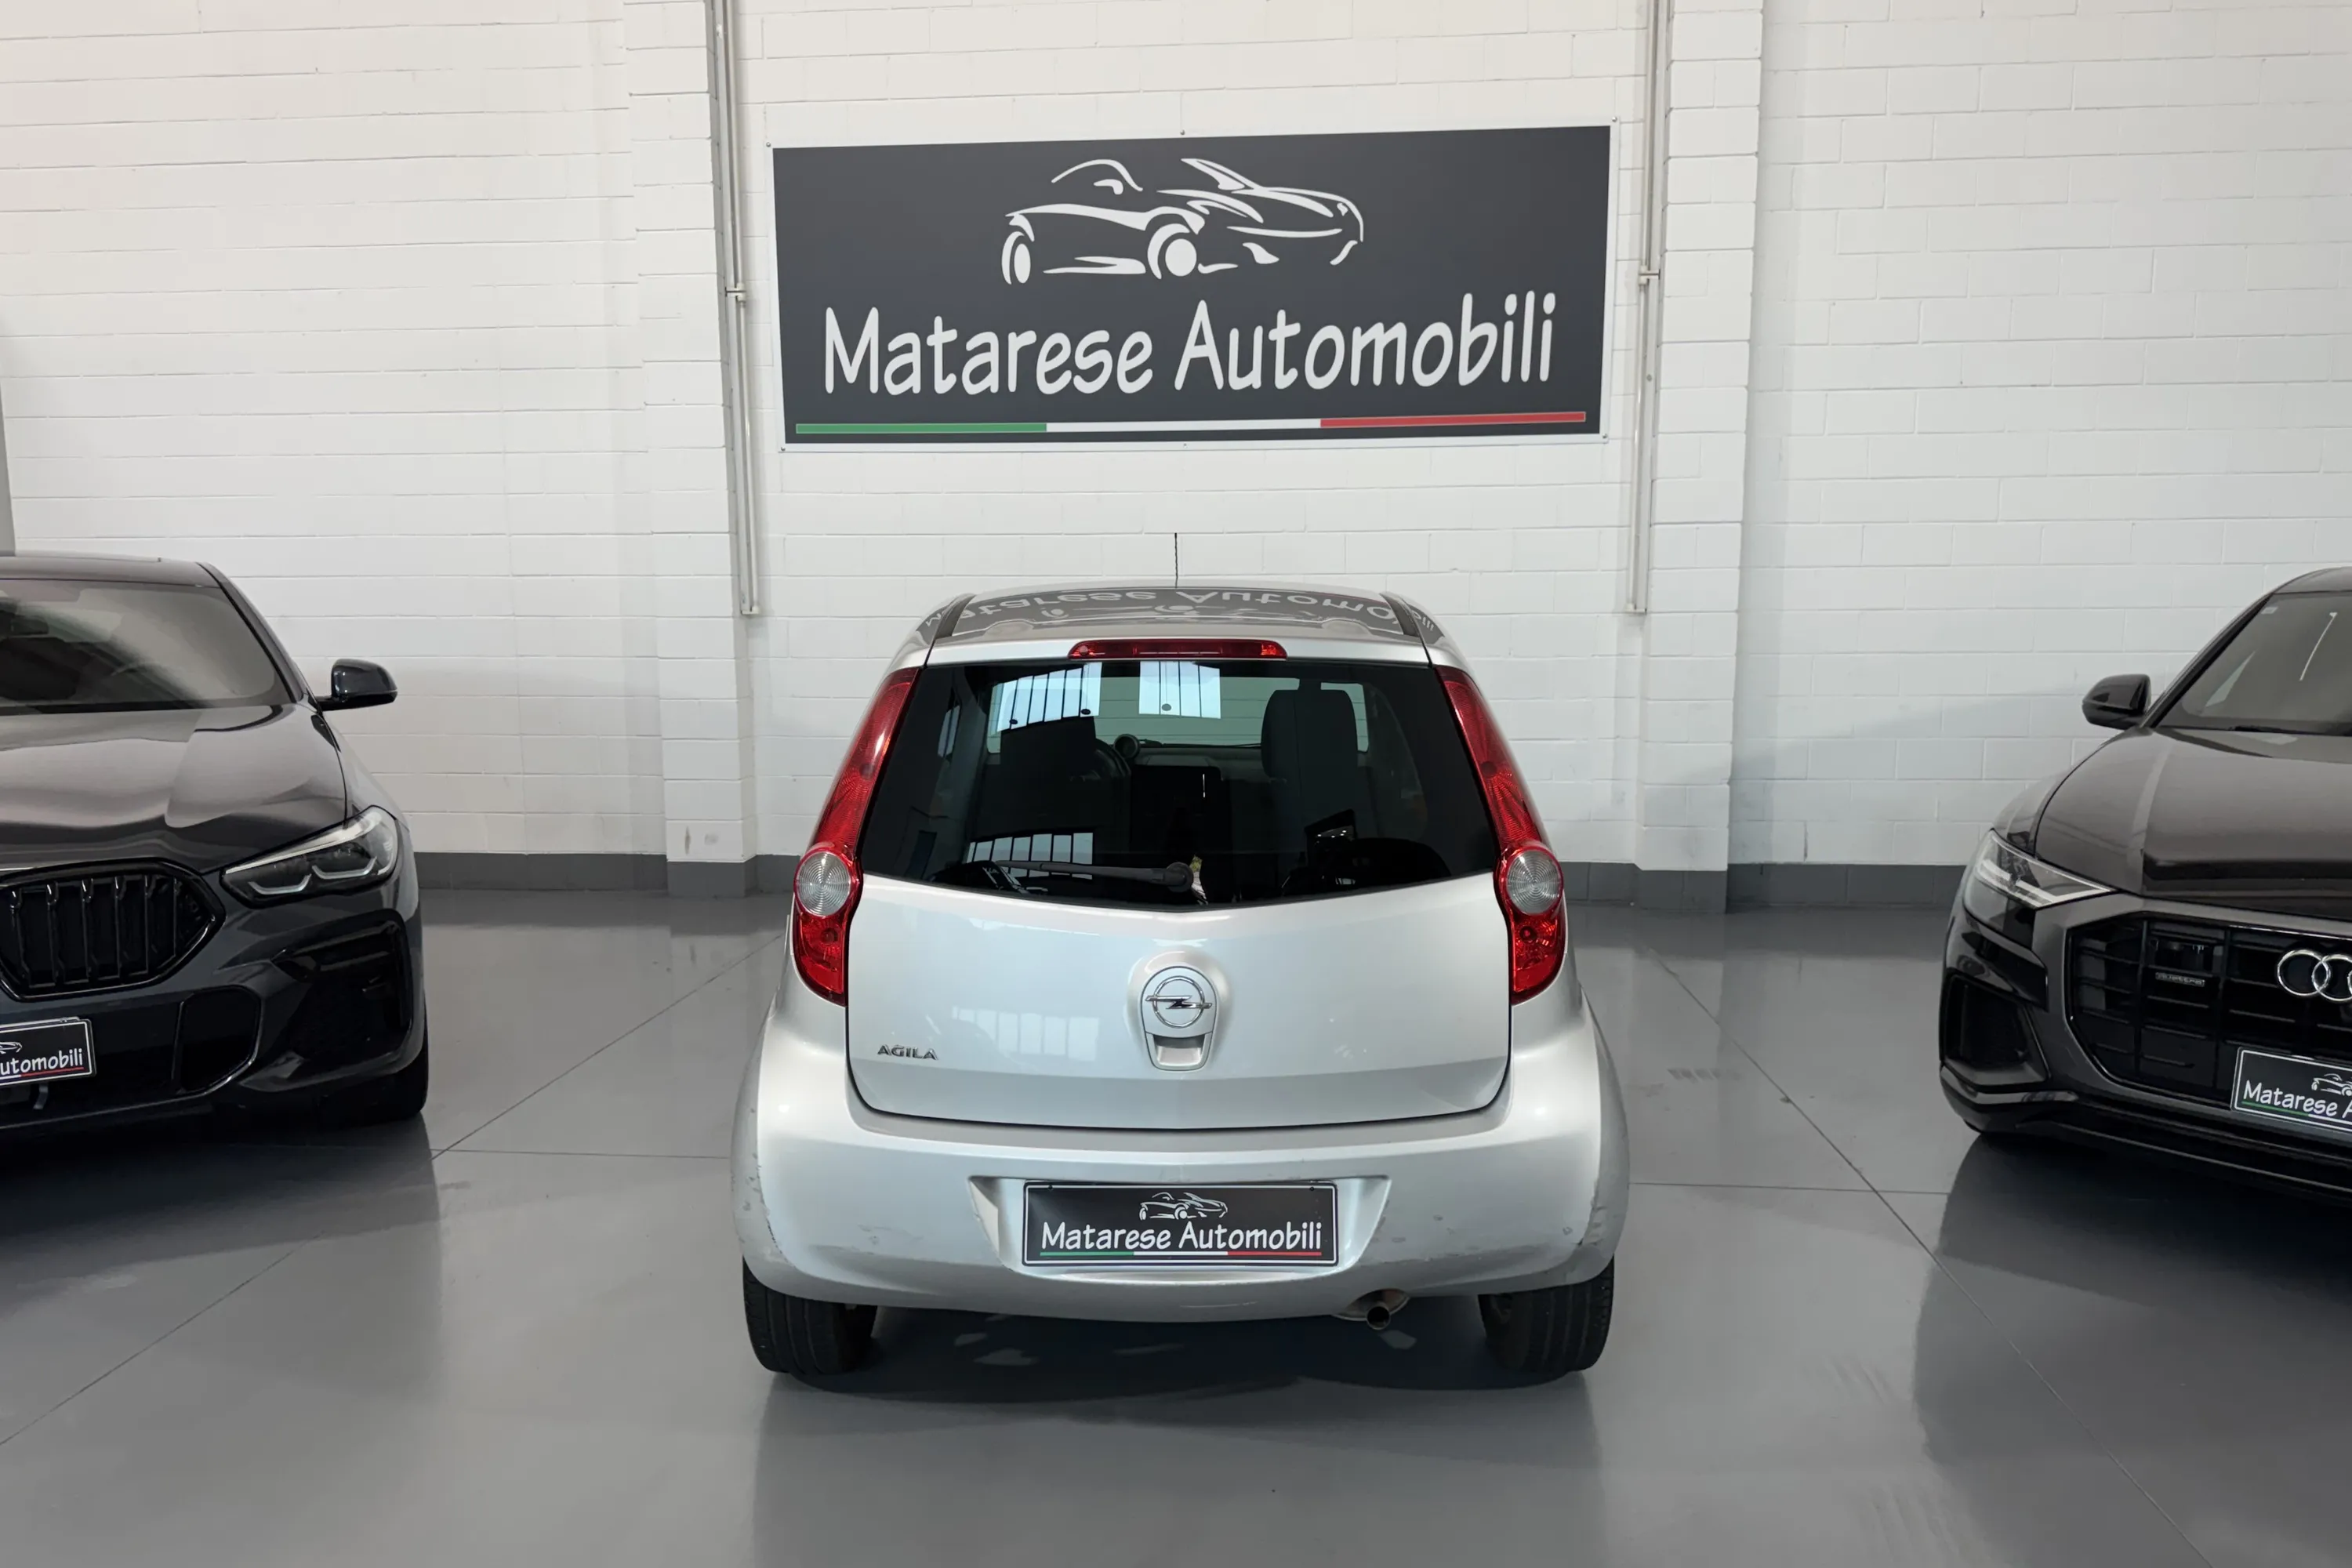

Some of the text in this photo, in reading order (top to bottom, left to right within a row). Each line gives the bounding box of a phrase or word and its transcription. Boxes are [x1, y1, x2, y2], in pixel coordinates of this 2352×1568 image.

[826, 290, 1555, 395] Matarese Automobili
[0, 1048, 83, 1076] utomobili
[877, 1044, 938, 1060] AGILA
[2243, 1080, 2338, 1116] Matarese
[1042, 1221, 1322, 1250] Matarese Automobili
